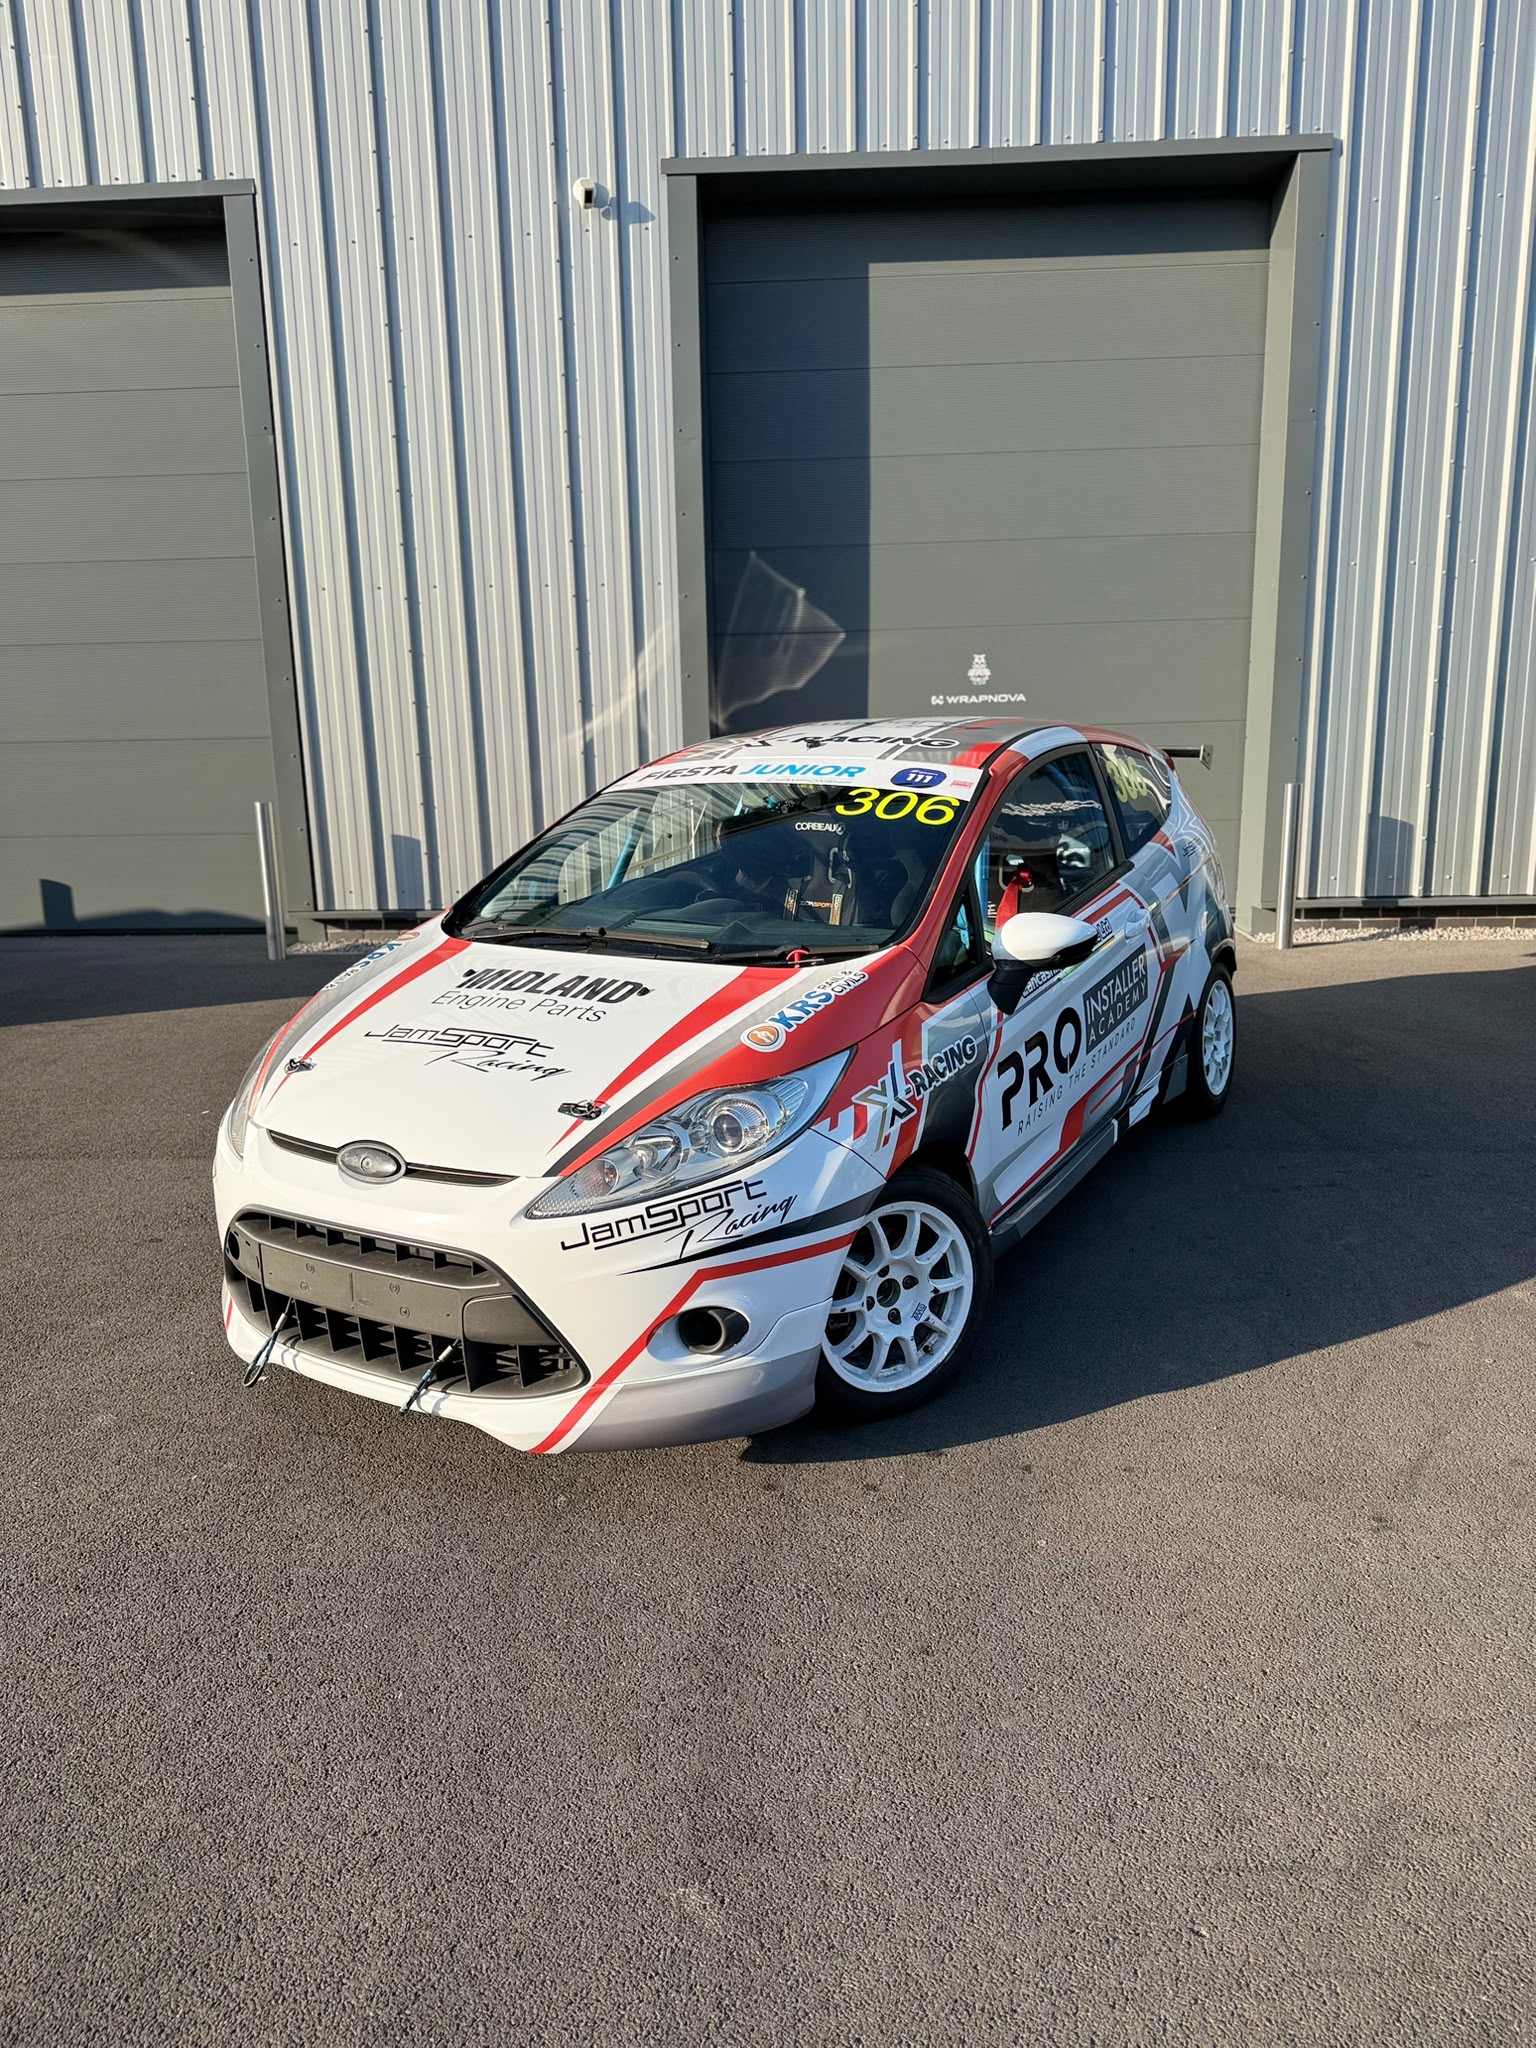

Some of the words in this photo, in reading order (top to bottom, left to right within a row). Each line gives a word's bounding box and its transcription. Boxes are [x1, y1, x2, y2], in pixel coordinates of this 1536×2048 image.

[945, 693, 1027, 704] WRAPNOVA
[638, 765, 739, 782] FIESTA
[740, 764, 866, 778] JUNIOR
[1105, 756, 1147, 803] 306
[835, 787, 961, 826] 306
[795, 822, 837, 832] CORBEAU
[456, 968, 646, 1004] MIDLAND
[817, 974, 844, 990] RAIL
[831, 972, 866, 994] CIVILS
[1086, 955, 1146, 1025] INSTALLER
[431, 991, 526, 1011] Engine
[529, 998, 607, 1022] Parts
[768, 990, 832, 1029] KRS
[1088, 978, 1146, 1046] ACADEMY
[364, 1024, 555, 1057] JamSport
[424, 1050, 572, 1081] Racing
[997, 1007, 1082, 1132] PRO
[1018, 1084, 1063, 1137] RAISING
[1069, 1063, 1086, 1089] THE
[1090, 1017, 1136, 1069] STANDARD
[561, 1179, 768, 1250] JamSport
[664, 1193, 798, 1259] Racing
